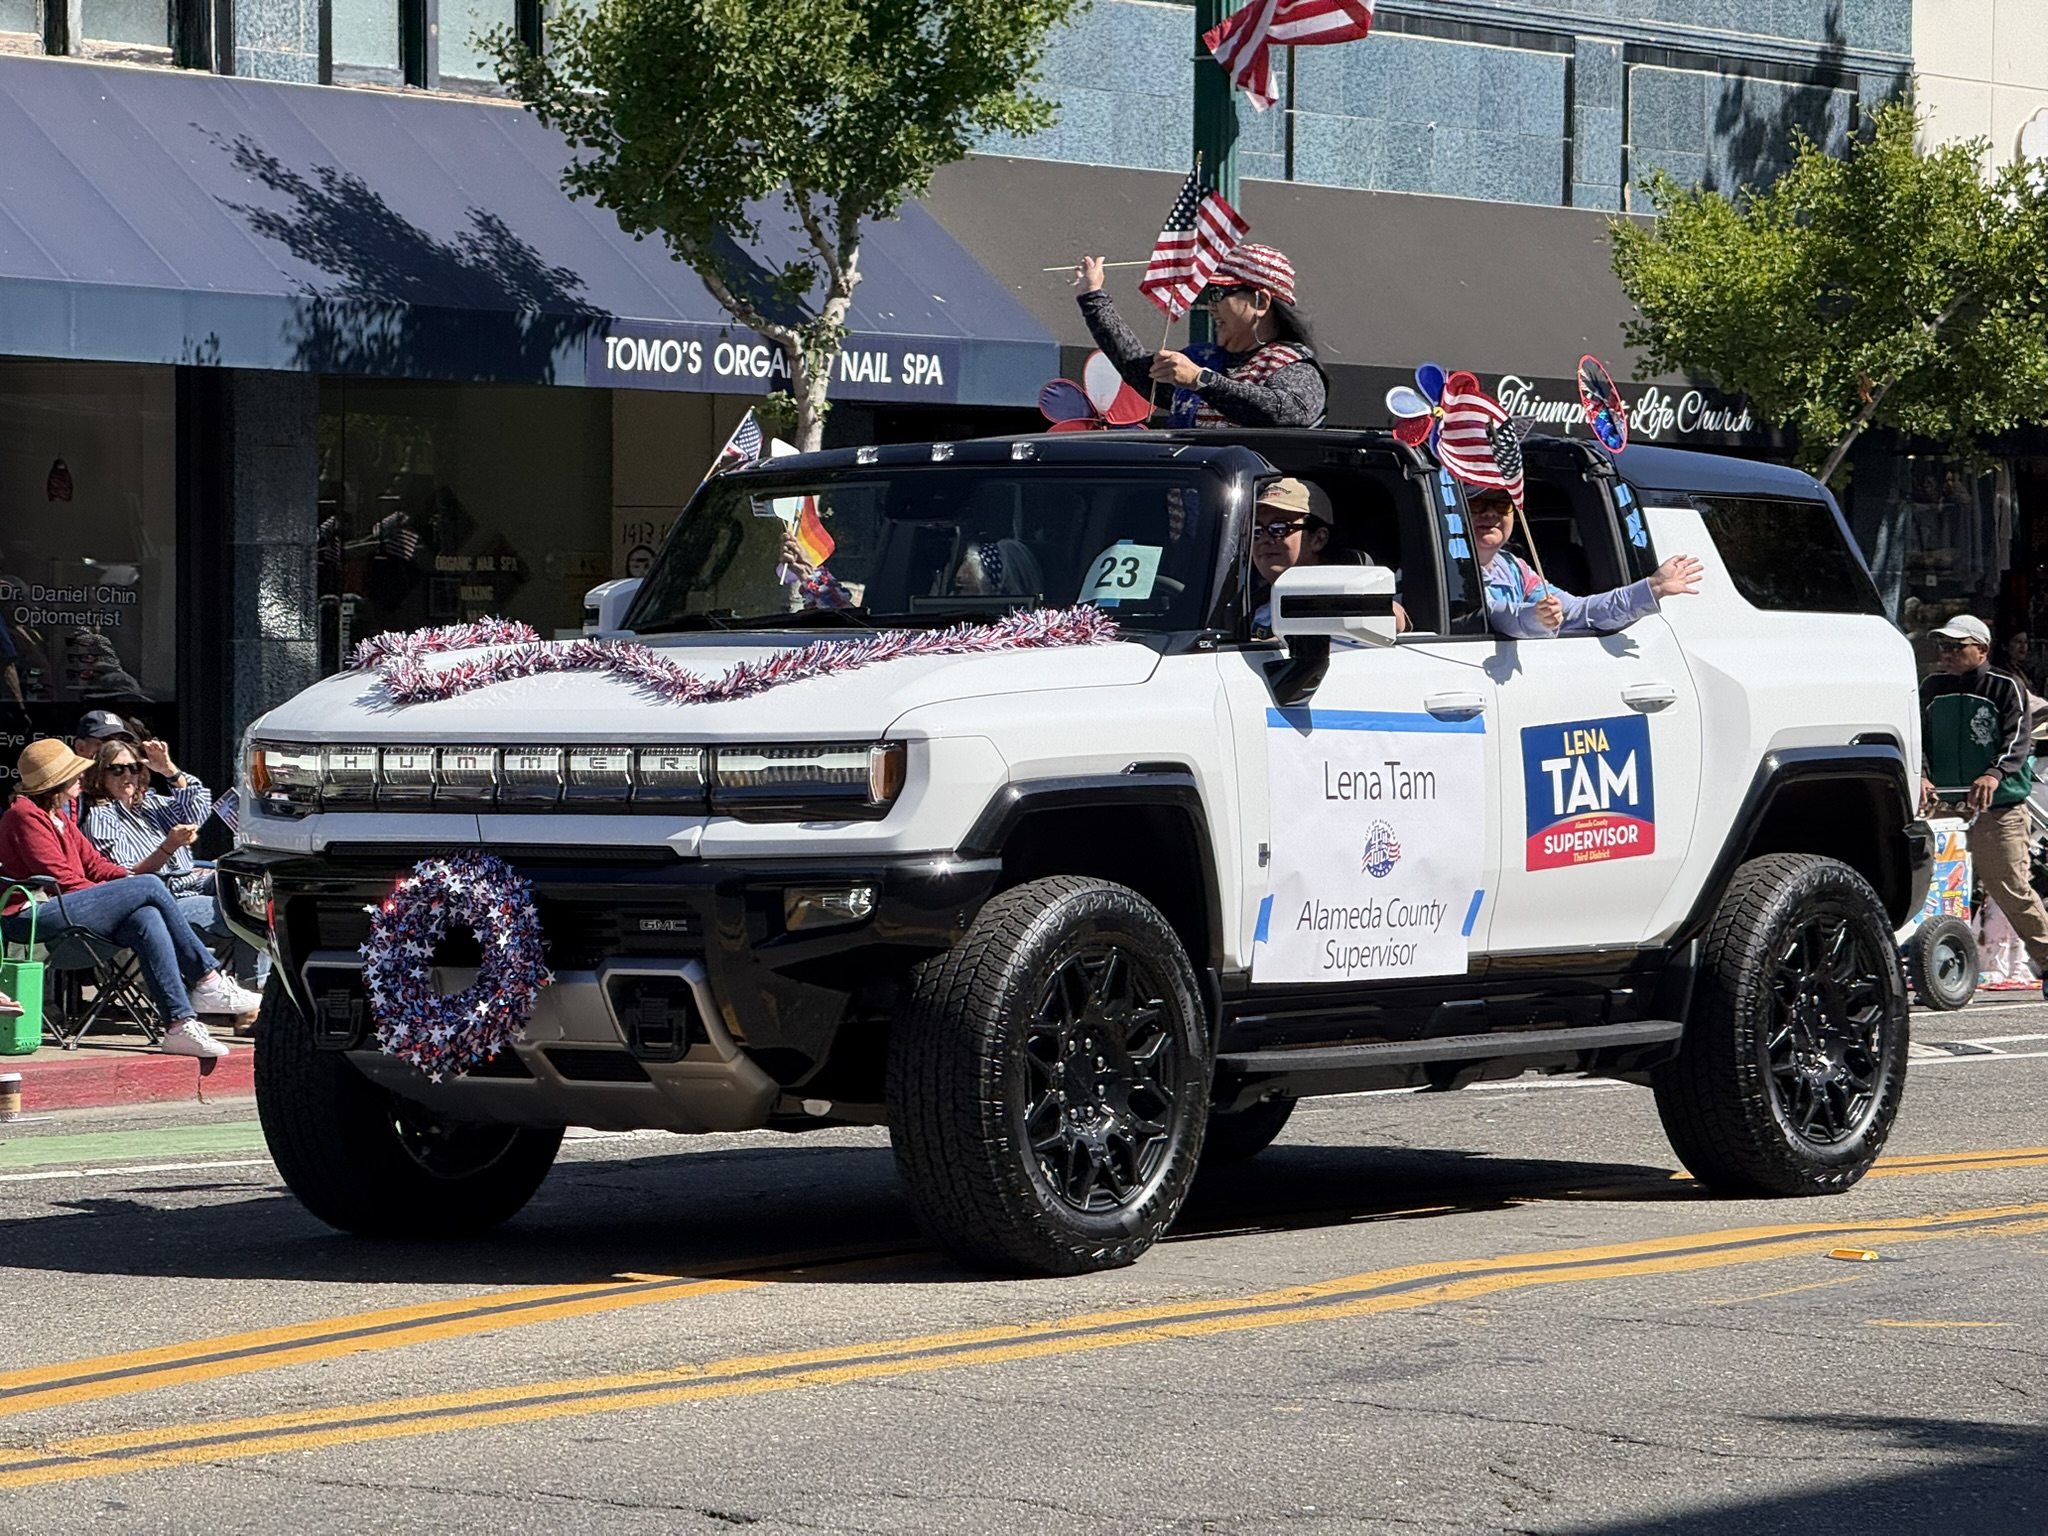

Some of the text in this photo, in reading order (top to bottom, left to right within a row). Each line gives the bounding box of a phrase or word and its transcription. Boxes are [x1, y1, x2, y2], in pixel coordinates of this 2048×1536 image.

[605, 336, 944, 385] TOMO'S ORGA NAIL SPA
[1497, 374, 1754, 440] Triumph Life Church
[1094, 556, 1140, 589] 23
[0, 584, 137, 604] Dr. Daniel Chin
[14, 606, 121, 628] Optometrist
[1563, 727, 1610, 756] LENA
[343, 756, 679, 770] HUMMER
[1324, 761, 1436, 800] Lena Tam
[1541, 749, 1638, 815] TAM
[1544, 825, 1638, 854] SUPERVISOR
[1369, 847, 1390, 867] JULY
[1573, 849, 1610, 862] Third District
[639, 919, 688, 931] GMC
[1296, 898, 1447, 934] Alameda County
[1323, 937, 1418, 977] Supervisor
